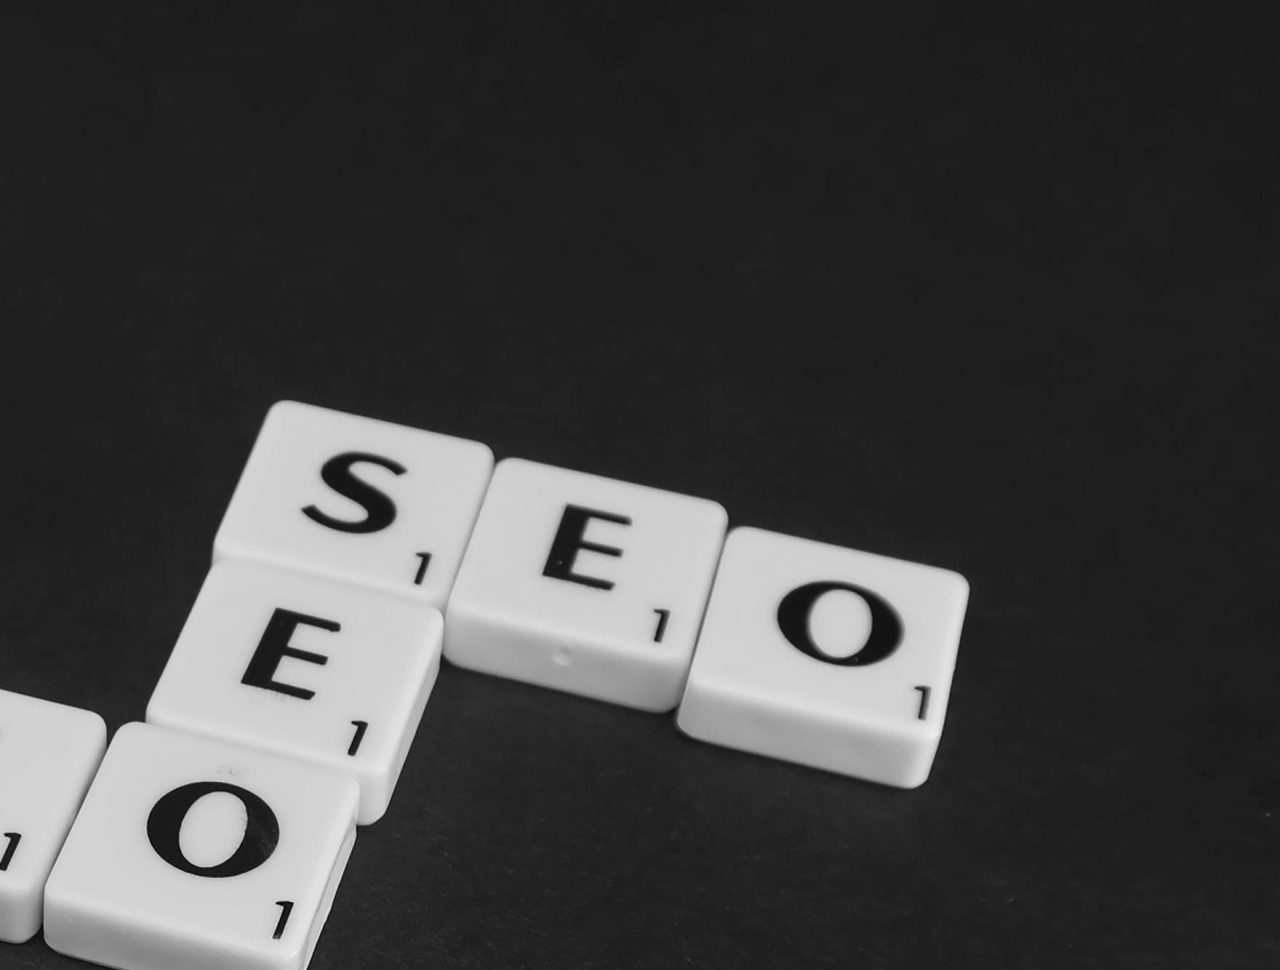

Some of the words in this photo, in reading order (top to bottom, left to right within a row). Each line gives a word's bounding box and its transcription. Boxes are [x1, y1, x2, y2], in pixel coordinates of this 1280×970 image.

[414, 552, 432, 585] 1
[653, 609, 670, 643] 1
[914, 686, 931, 720] 1
[347, 721, 368, 756] 1
[272, 901, 294, 939] 1
